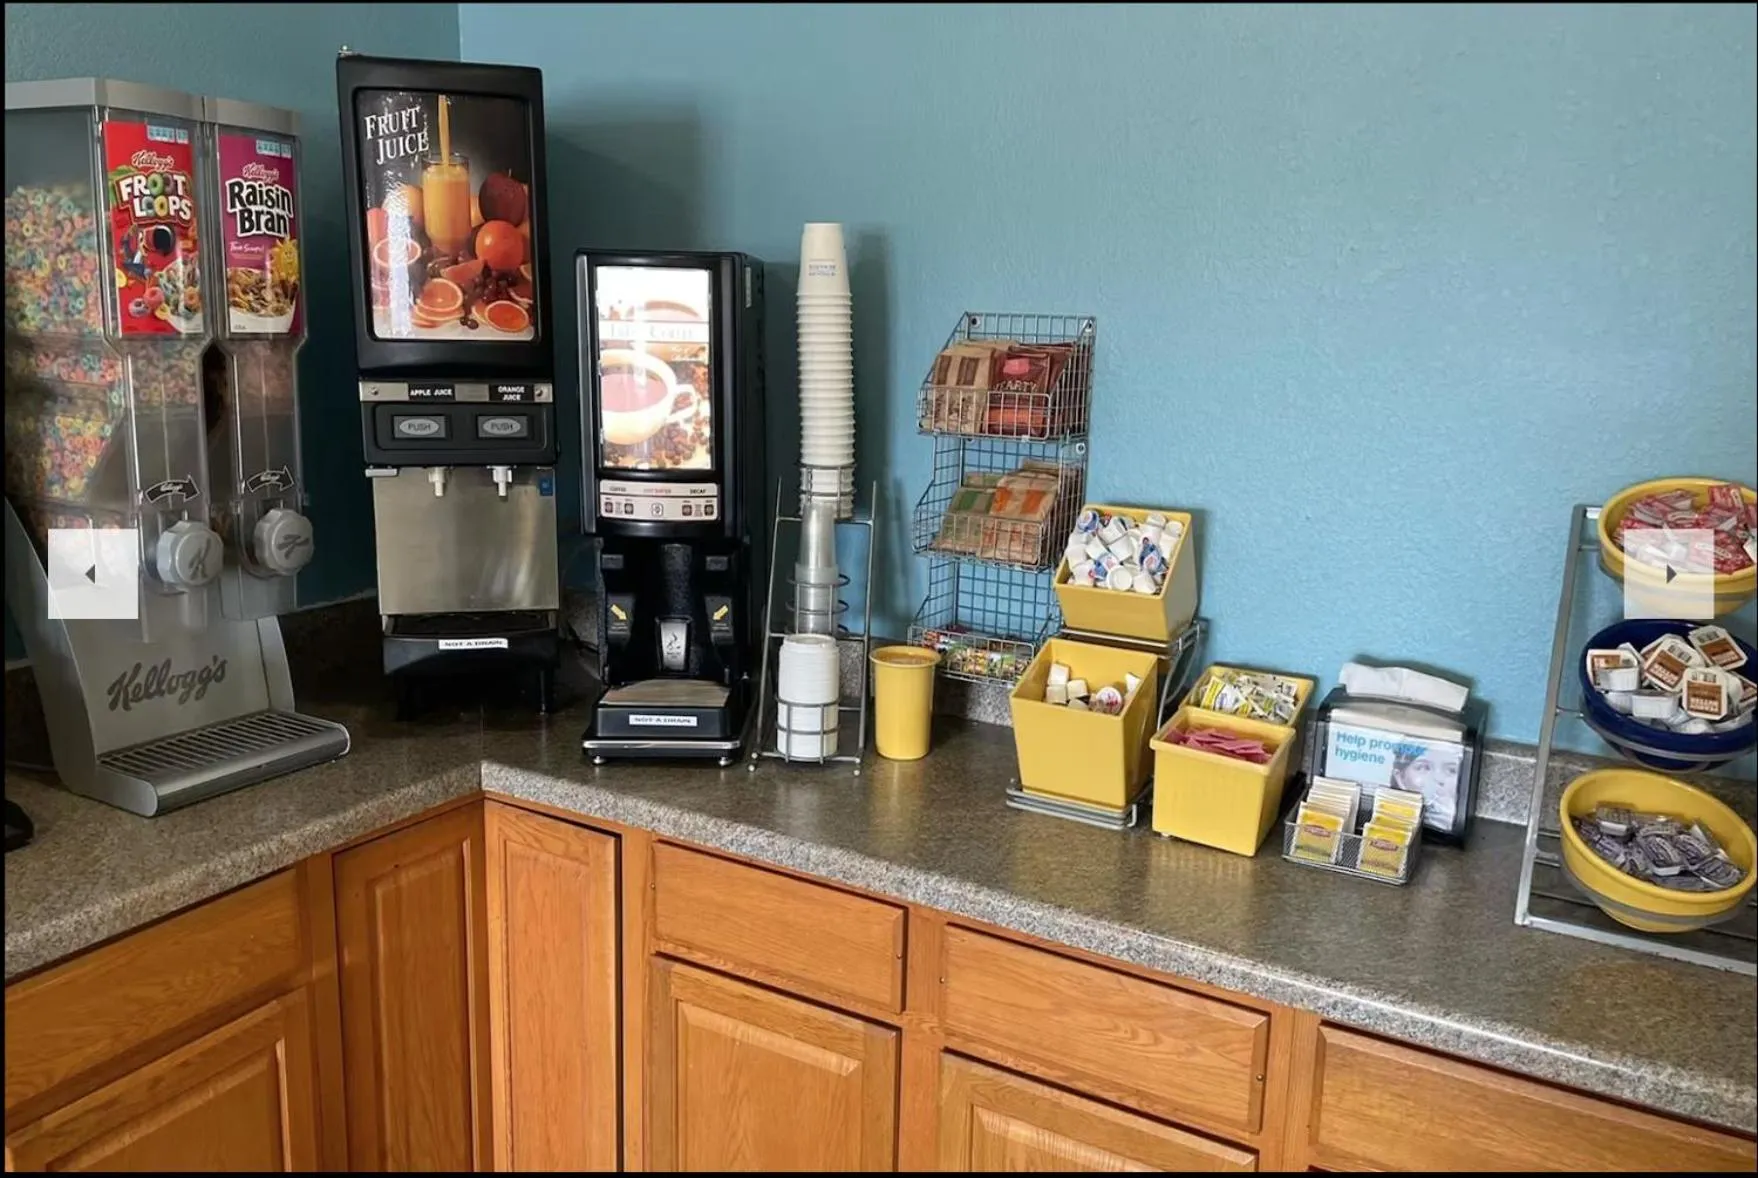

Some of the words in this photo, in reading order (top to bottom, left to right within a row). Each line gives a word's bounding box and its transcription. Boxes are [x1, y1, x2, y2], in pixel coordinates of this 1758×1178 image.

[364, 105, 421, 140] FRUIT
[376, 131, 430, 165] JUICE
[119, 173, 187, 202] FROOT
[226, 179, 293, 217] Raisin
[133, 195, 193, 221] LOOPS
[238, 207, 289, 237] Bran
[410, 388, 431, 396] APPLE
[434, 388, 453, 396] JUICE
[407, 423, 431, 431] PUSH
[491, 423, 514, 431] PUSH
[107, 654, 228, 712] Kellogg's
[1336, 731, 1367, 747] Help
[1335, 745, 1386, 765] hygiene
